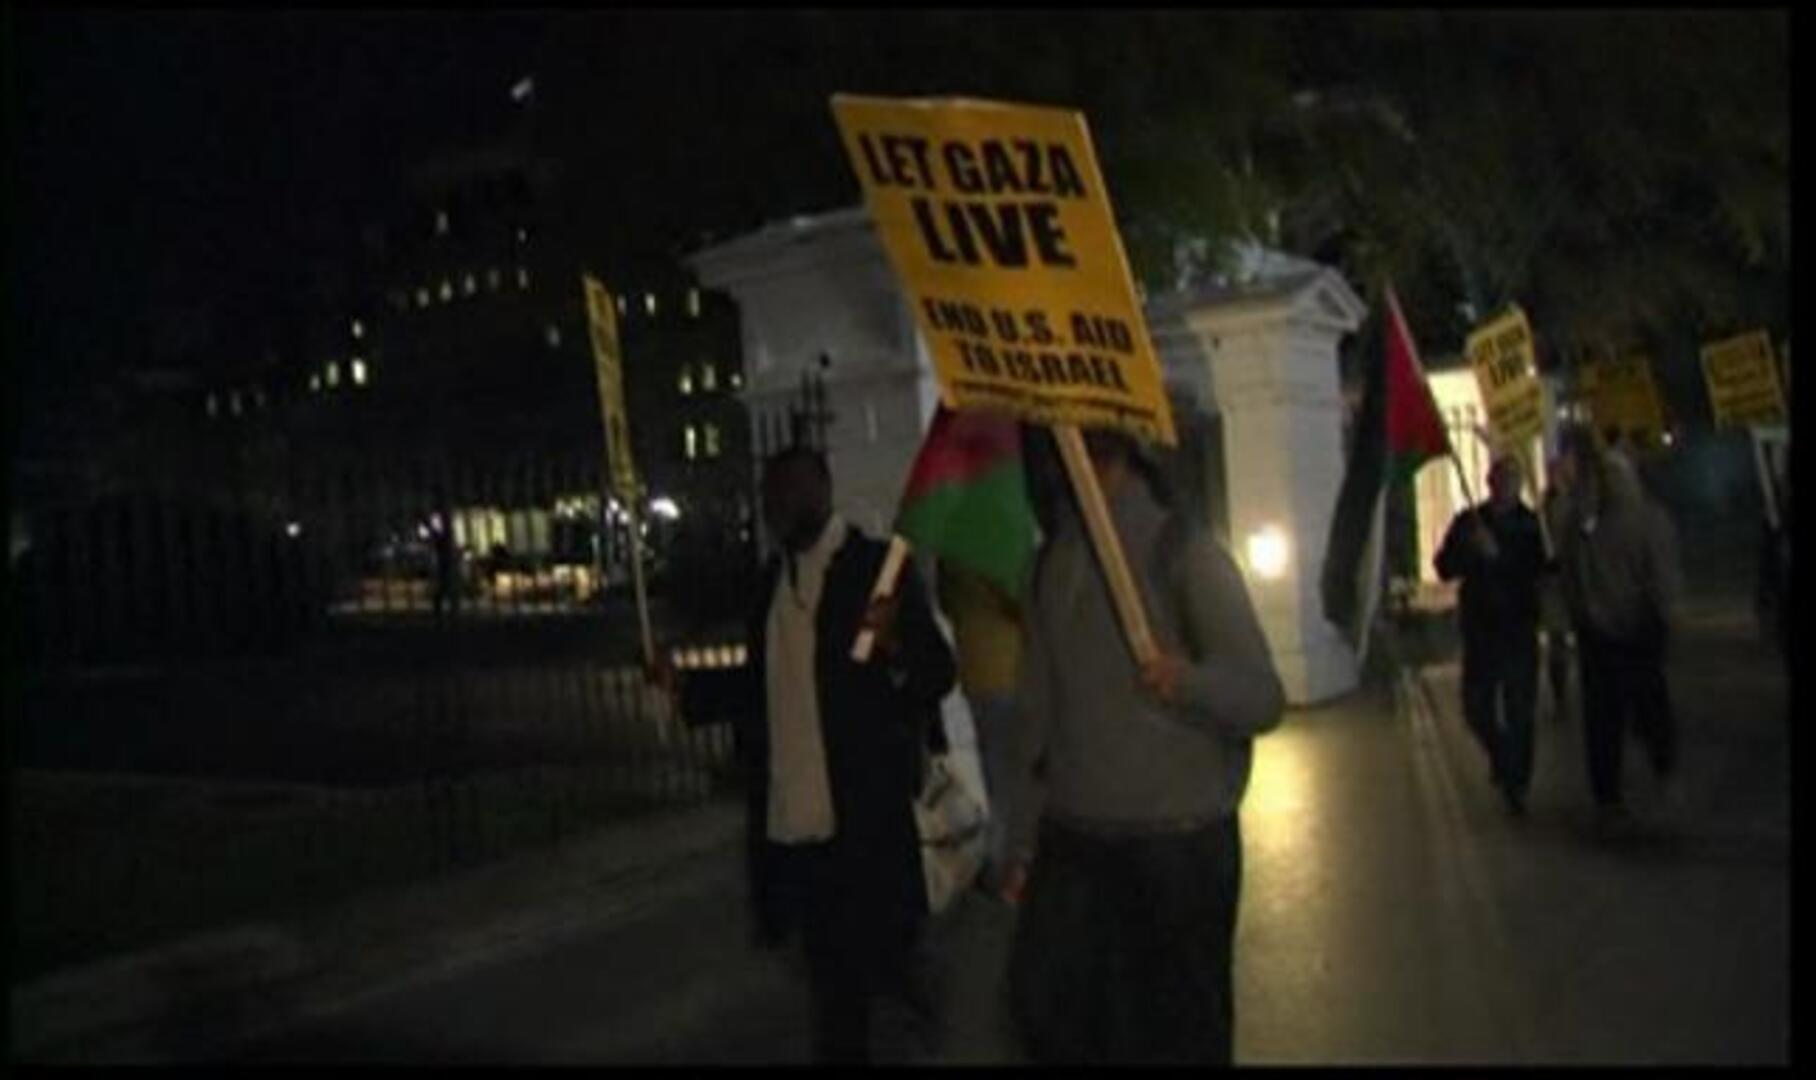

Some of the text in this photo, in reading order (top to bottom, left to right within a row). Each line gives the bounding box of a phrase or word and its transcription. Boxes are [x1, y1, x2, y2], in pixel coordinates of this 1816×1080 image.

[858, 132, 1087, 197] LET GAZA
[911, 198, 1076, 268] LIVE
[921, 298, 1134, 355] END U.S. AID
[953, 338, 1132, 394] TO ISRAEL
